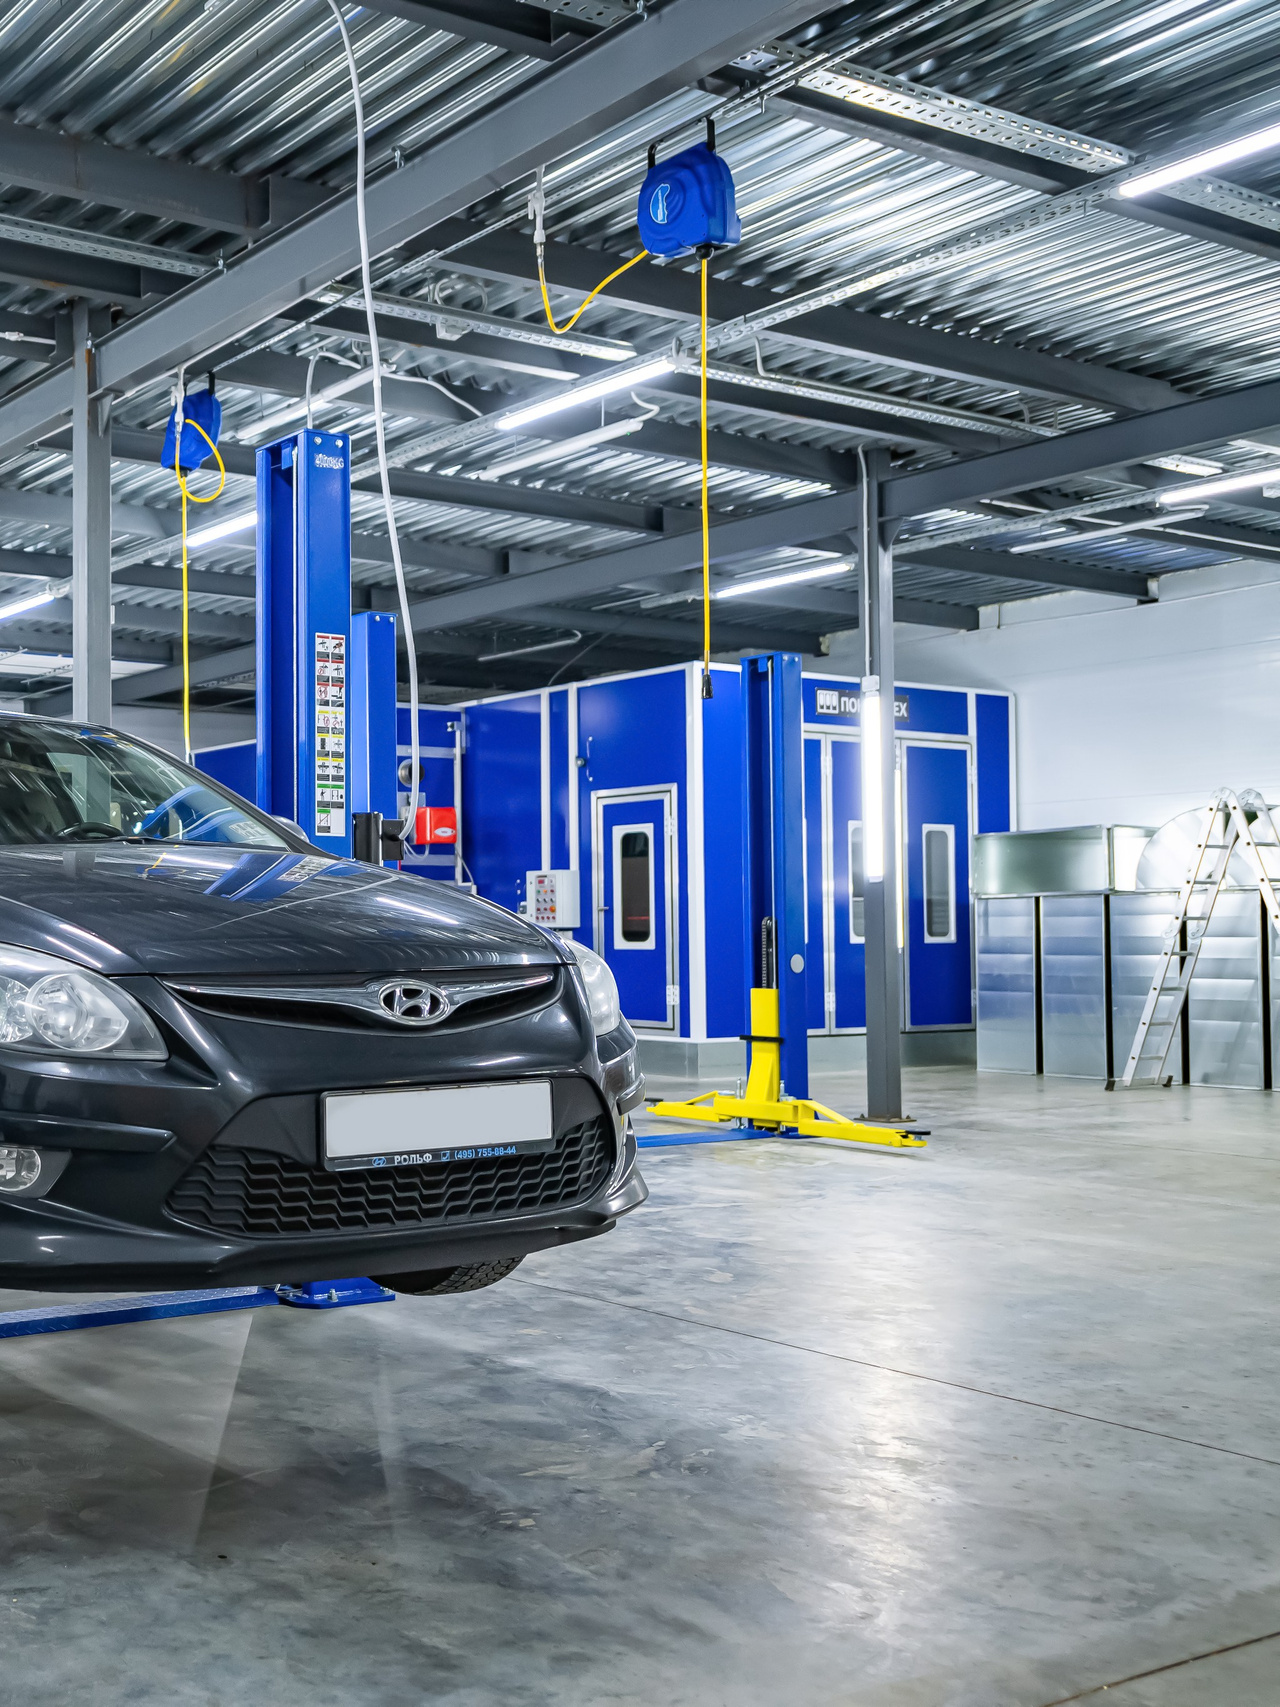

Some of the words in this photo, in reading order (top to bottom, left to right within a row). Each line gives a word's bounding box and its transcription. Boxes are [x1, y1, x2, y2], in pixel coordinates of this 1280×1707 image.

[394, 1152, 433, 1166] РОЛЬФ
[454, 1148, 476, 1160] (495)
[477, 1145, 517, 1158] 755-88-44
